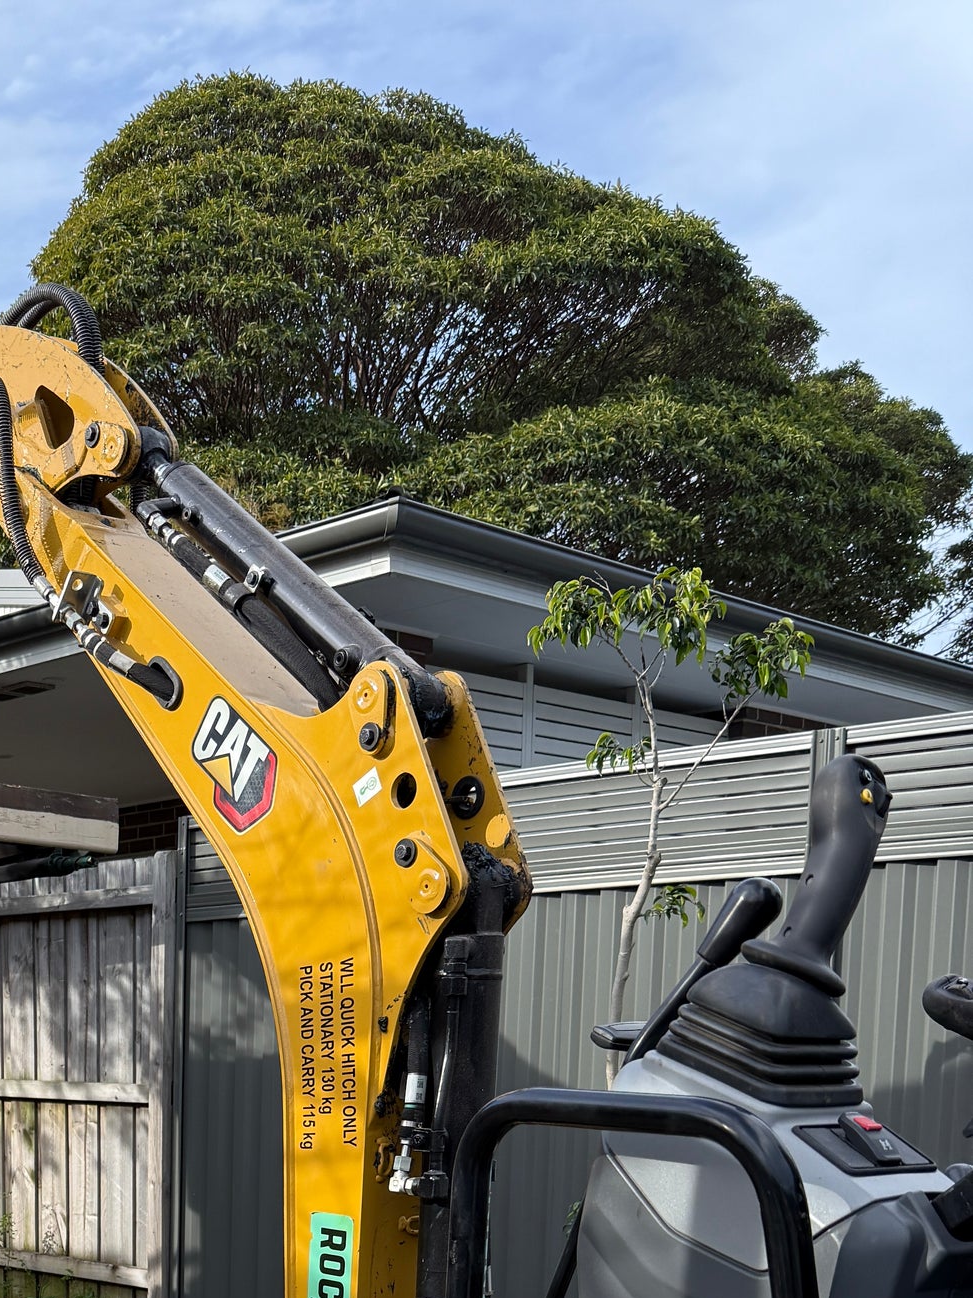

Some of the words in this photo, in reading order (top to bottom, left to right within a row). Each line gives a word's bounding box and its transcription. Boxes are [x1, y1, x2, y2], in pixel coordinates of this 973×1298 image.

[192, 697, 271, 802] CAT
[299, 965, 314, 1003] PICK
[340, 957, 354, 994] WLL
[300, 1007, 314, 1040] AND
[319, 961, 335, 1060] STATIONARY
[340, 999, 356, 1048] QUICK
[301, 1044, 316, 1098] CARRY
[321, 1066, 335, 1092] 130
[341, 1052, 356, 1101] HITCH
[302, 1104, 316, 1128] 115
[319, 1097, 335, 1114] kg
[299, 1132, 316, 1150] kg
[342, 1105, 357, 1147] ONLY
